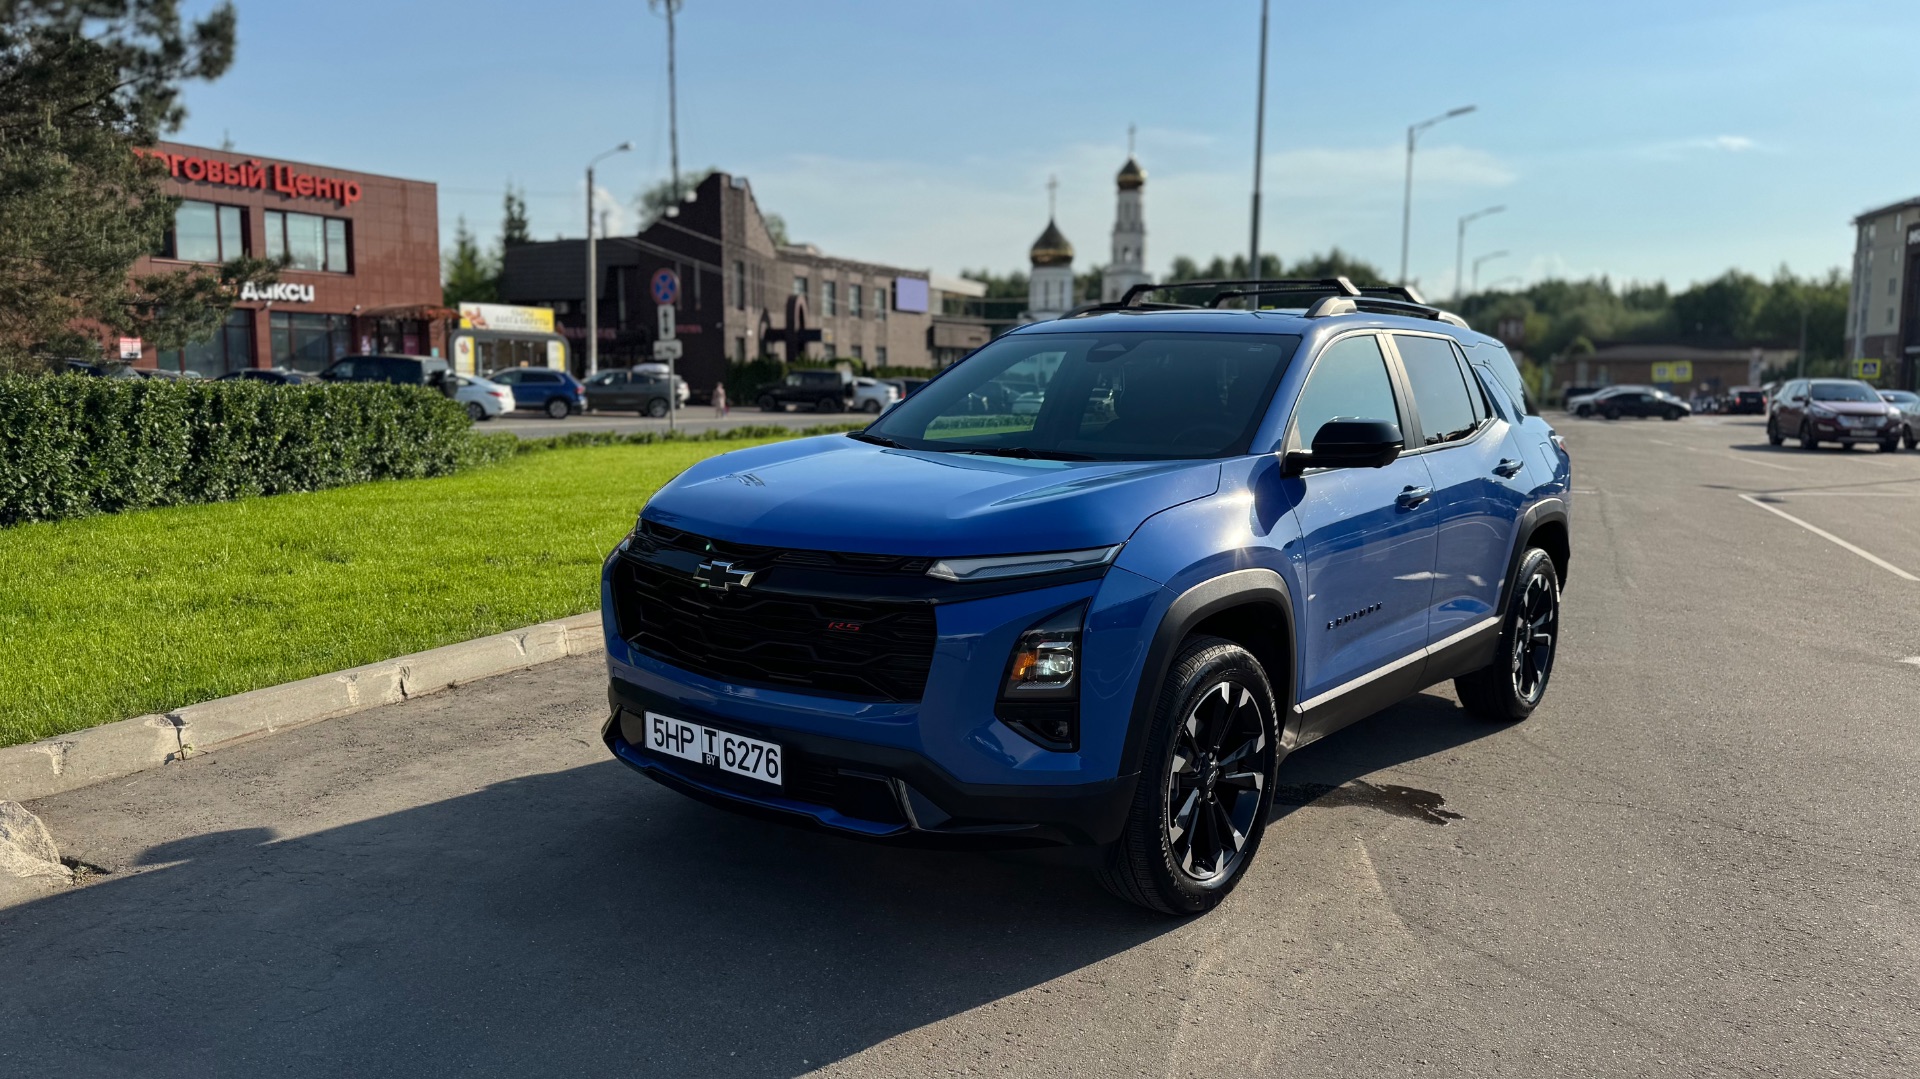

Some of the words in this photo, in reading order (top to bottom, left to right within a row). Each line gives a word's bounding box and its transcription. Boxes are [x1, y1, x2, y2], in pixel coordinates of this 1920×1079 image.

[274, 163, 362, 207] Центр
[828, 621, 860, 632] RS
[653, 717, 694, 754] 5HP
[703, 729, 717, 753] T
[723, 737, 779, 779] 6276
[705, 754, 716, 766] BY
